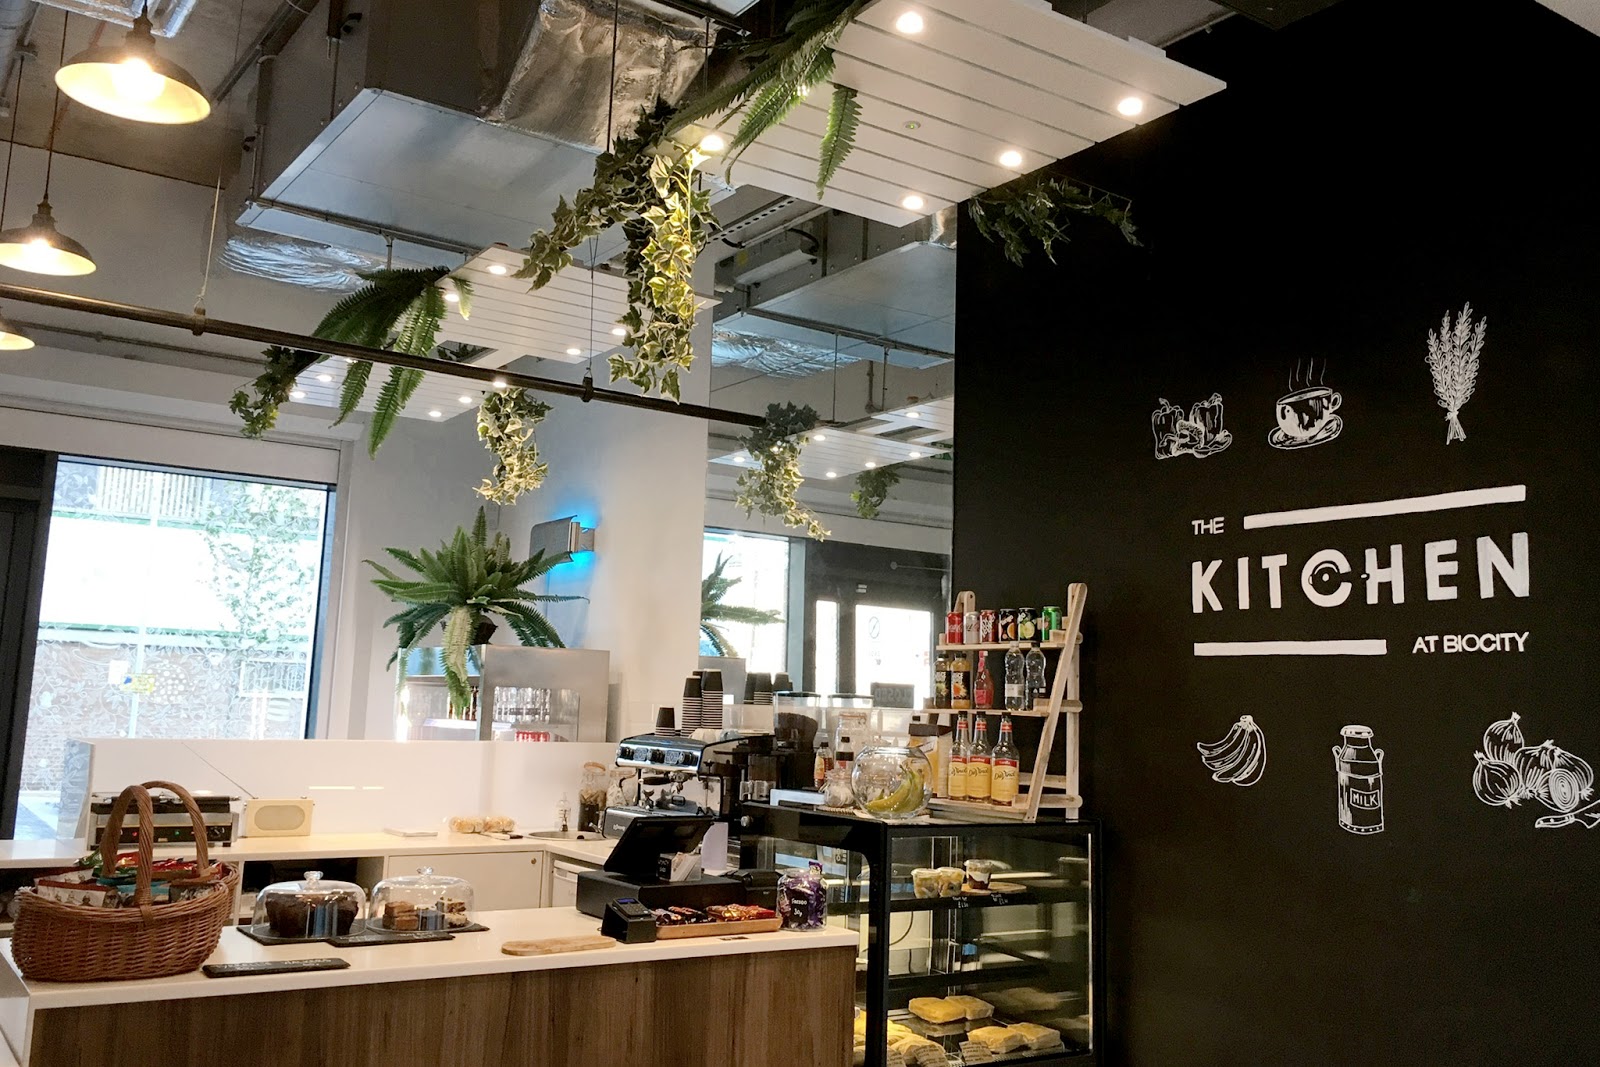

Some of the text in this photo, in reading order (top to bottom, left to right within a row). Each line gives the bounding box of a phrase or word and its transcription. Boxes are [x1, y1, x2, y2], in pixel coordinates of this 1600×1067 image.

[1192, 517, 1224, 535] THE
[1192, 532, 1530, 613] KITCHEN
[1412, 632, 1530, 654] AT BIOCITY
[1353, 793, 1378, 807] MILK
